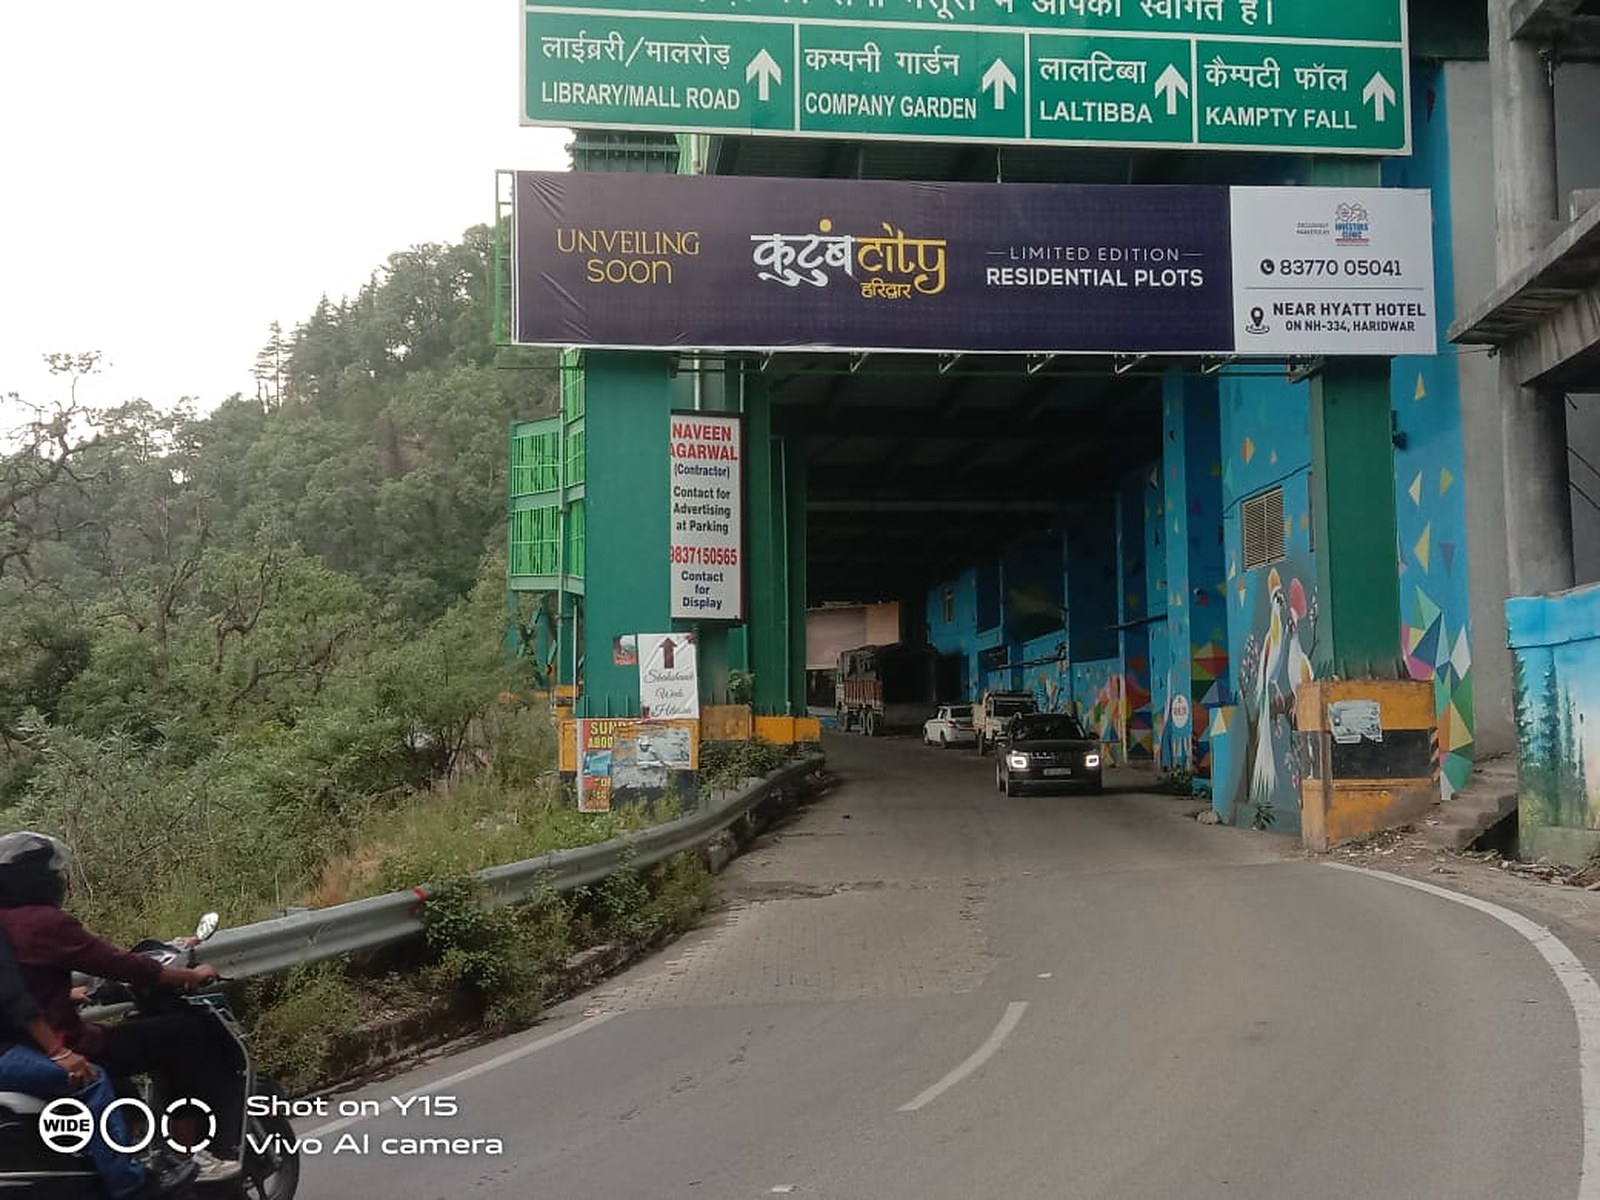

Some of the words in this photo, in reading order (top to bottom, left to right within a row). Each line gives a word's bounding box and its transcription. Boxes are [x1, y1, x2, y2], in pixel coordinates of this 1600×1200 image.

[804, 41, 881, 74] कम्पनी
[894, 45, 960, 77] गार्डन
[1038, 51, 1147, 84] लालटिब्बा
[1204, 55, 1281, 89] कैम्पटी
[1294, 63, 1348, 91] फॉल
[541, 81, 681, 108] LIBRARY/MALL
[686, 87, 740, 110] ROAD
[805, 92, 895, 117] COMPANY
[900, 97, 976, 119] GARDEN
[1039, 101, 1152, 124] LALTIBBA
[1205, 106, 1297, 127] KAMPTY
[1304, 109, 1357, 130] FALL
[556, 228, 700, 256] UNVEILING
[1010, 246, 1090, 261] LIMITED
[1098, 247, 1180, 262] EDITION
[1280, 259, 1338, 276] 83770
[1344, 260, 1402, 277] 05041
[986, 267, 1128, 287] RESIDENTIAL
[1135, 269, 1204, 288] PLOTS
[860, 277, 913, 299] हरिद्वार
[1273, 302, 1316, 317] NEAR
[1320, 302, 1373, 317] HYATT
[1376, 303, 1427, 318] HOTEL
[1285, 320, 1302, 332] ON
[1353, 320, 1415, 332] HARIDWAR
[672, 424, 732, 441] NAVEEN
[671, 443, 738, 460] AGARWAL
[673, 486, 714, 498] Contact
[716, 487, 730, 499] for
[673, 502, 731, 519] Advertising
[676, 520, 686, 531] at
[690, 519, 729, 535] Parking
[681, 570, 724, 582] Contact
[695, 583, 711, 595] for
[682, 596, 722, 610] Display
